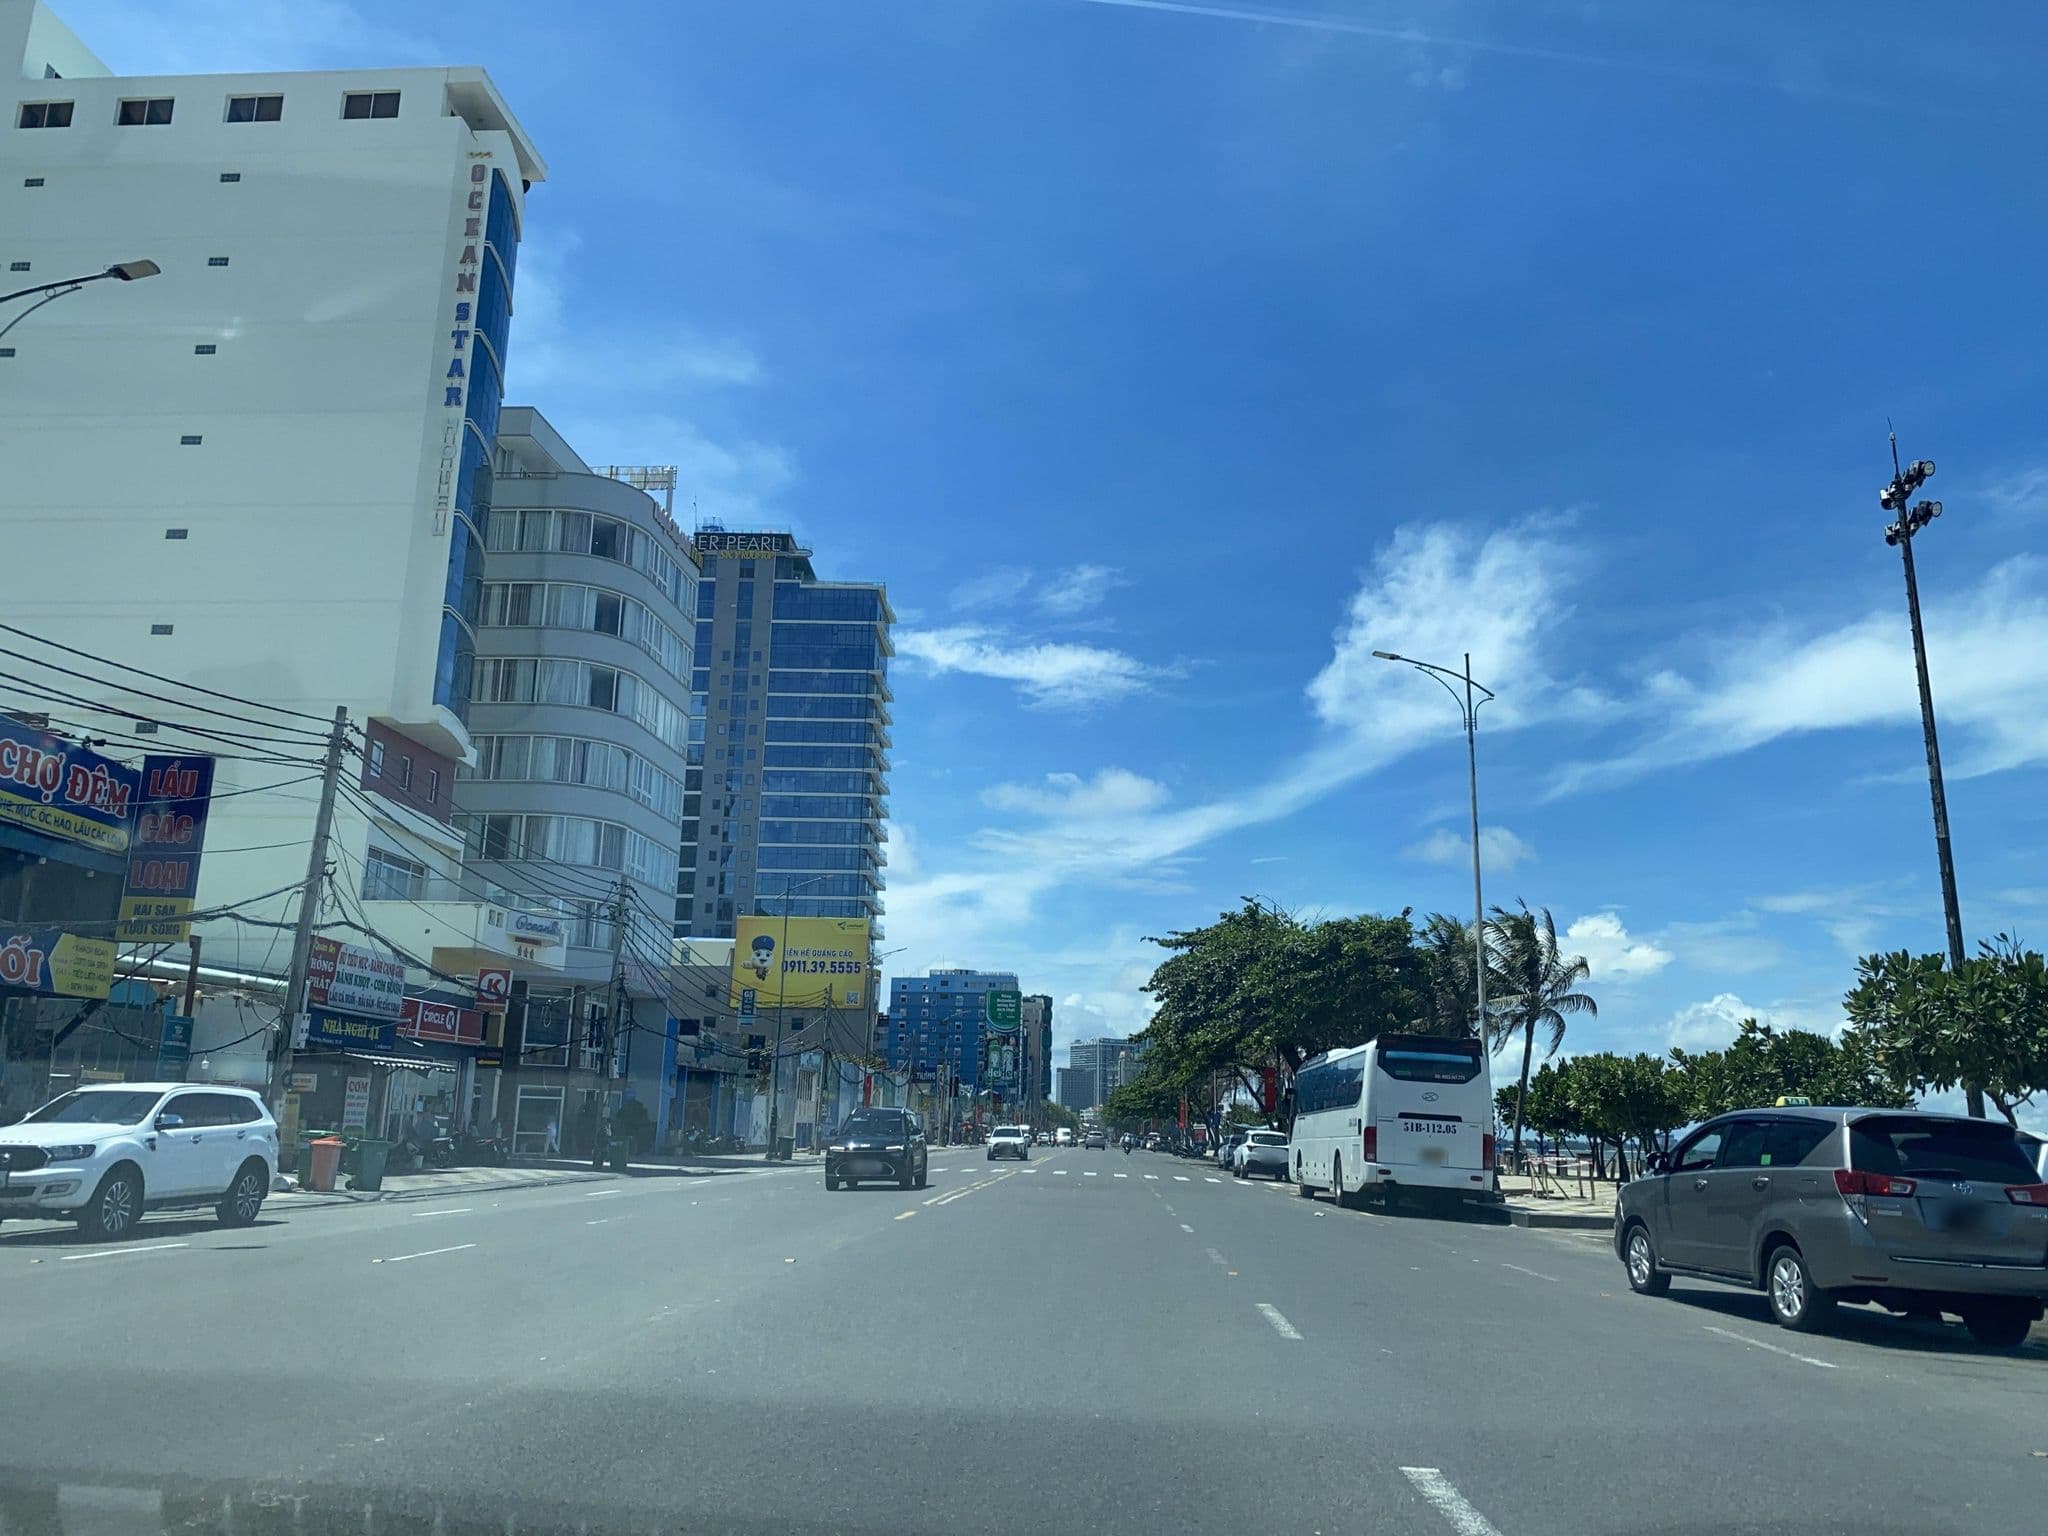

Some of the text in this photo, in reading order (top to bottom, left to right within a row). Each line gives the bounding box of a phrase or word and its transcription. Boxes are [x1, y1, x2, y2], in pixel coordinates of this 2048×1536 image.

[456, 163, 487, 294] OCEAN
[444, 302, 471, 407] STAR
[694, 535, 781, 552] ER PEARL
[0, 738, 131, 819] CHỢ ĐÊM
[139, 810, 194, 844] CÁC
[130, 861, 190, 895] LOẠI
[0, 935, 44, 989] ỐI
[783, 960, 861, 975] 0911.39.5555
[322, 1016, 344, 1035] NHÀ
[424, 1009, 446, 1025] CIRCLE
[1403, 1121, 1458, 1135] 51B-112.05
